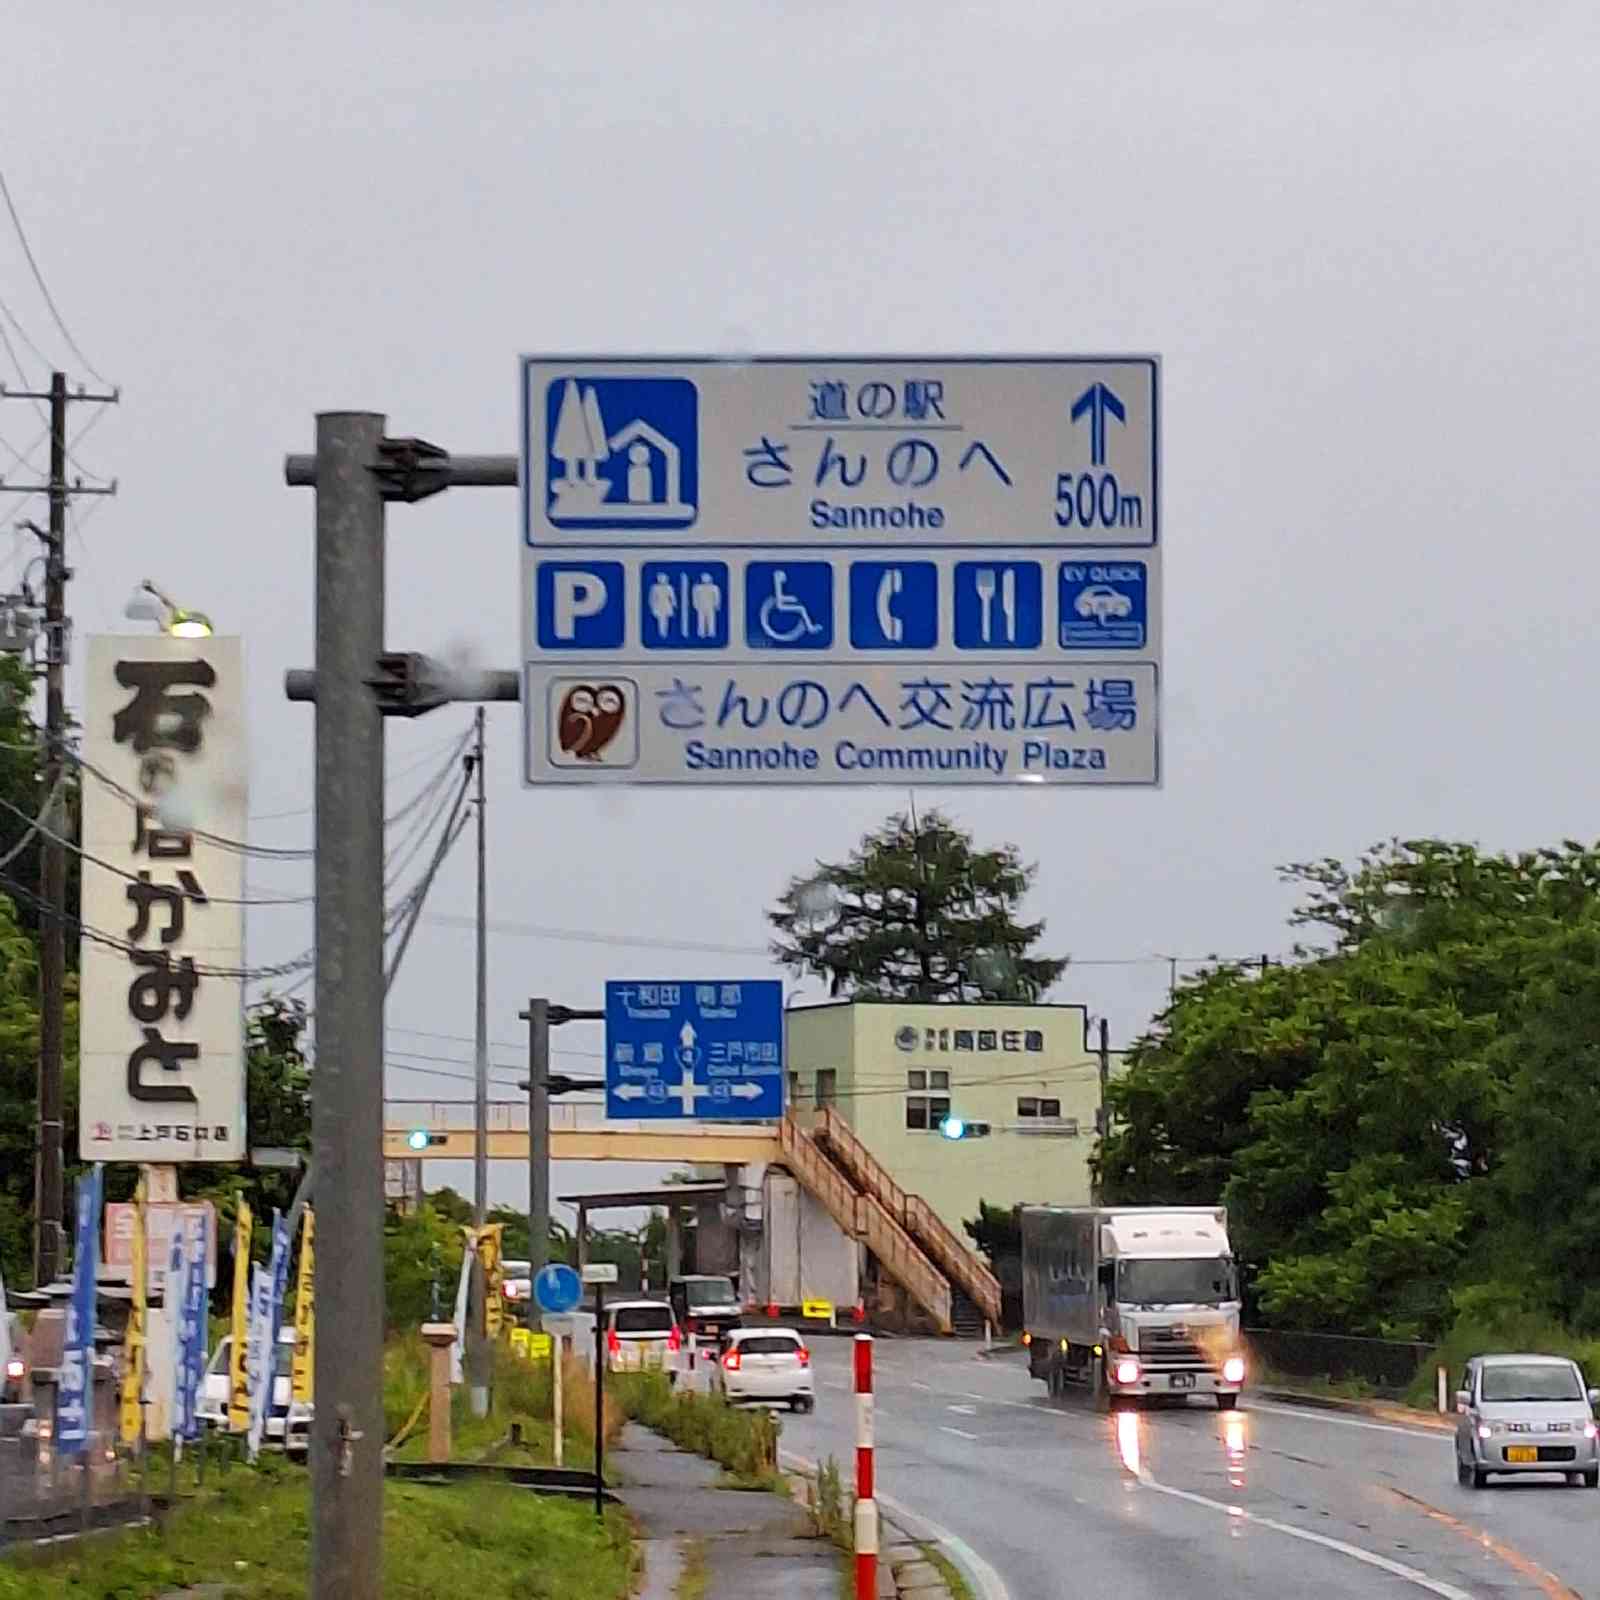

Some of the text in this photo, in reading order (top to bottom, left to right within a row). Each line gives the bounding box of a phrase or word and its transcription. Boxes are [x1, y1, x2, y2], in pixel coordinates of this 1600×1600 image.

[809, 379, 946, 421] 道の駅
[744, 434, 1014, 488] さんのへ
[811, 502, 944, 530] Sannohe
[1055, 470, 1141, 530] 500m
[655, 677, 1137, 735] さんのへ交流広場
[686, 742, 1106, 775] Sannohe Community Plaza
